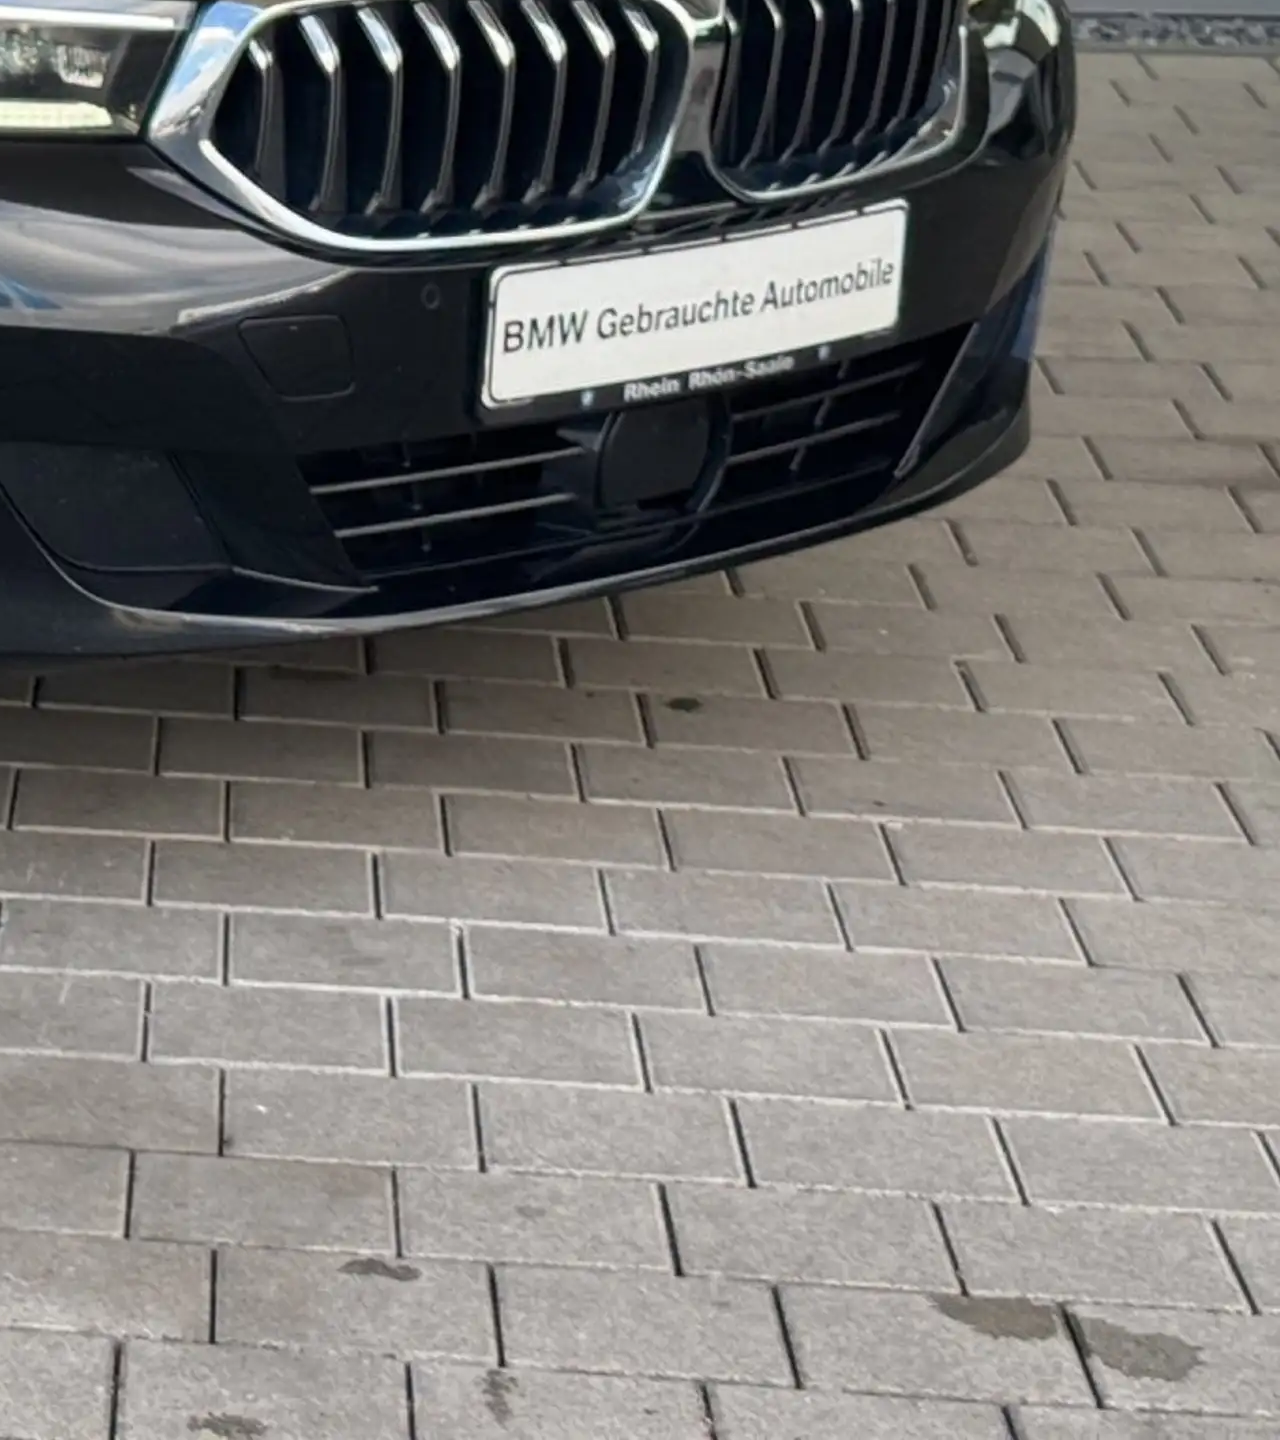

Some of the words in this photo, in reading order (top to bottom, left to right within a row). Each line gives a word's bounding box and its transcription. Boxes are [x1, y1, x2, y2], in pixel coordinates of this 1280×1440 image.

[502, 309, 590, 353] BMW
[596, 289, 755, 340] Gebrauchte
[759, 257, 894, 313] Automobile
[623, 375, 680, 402] Rhein
